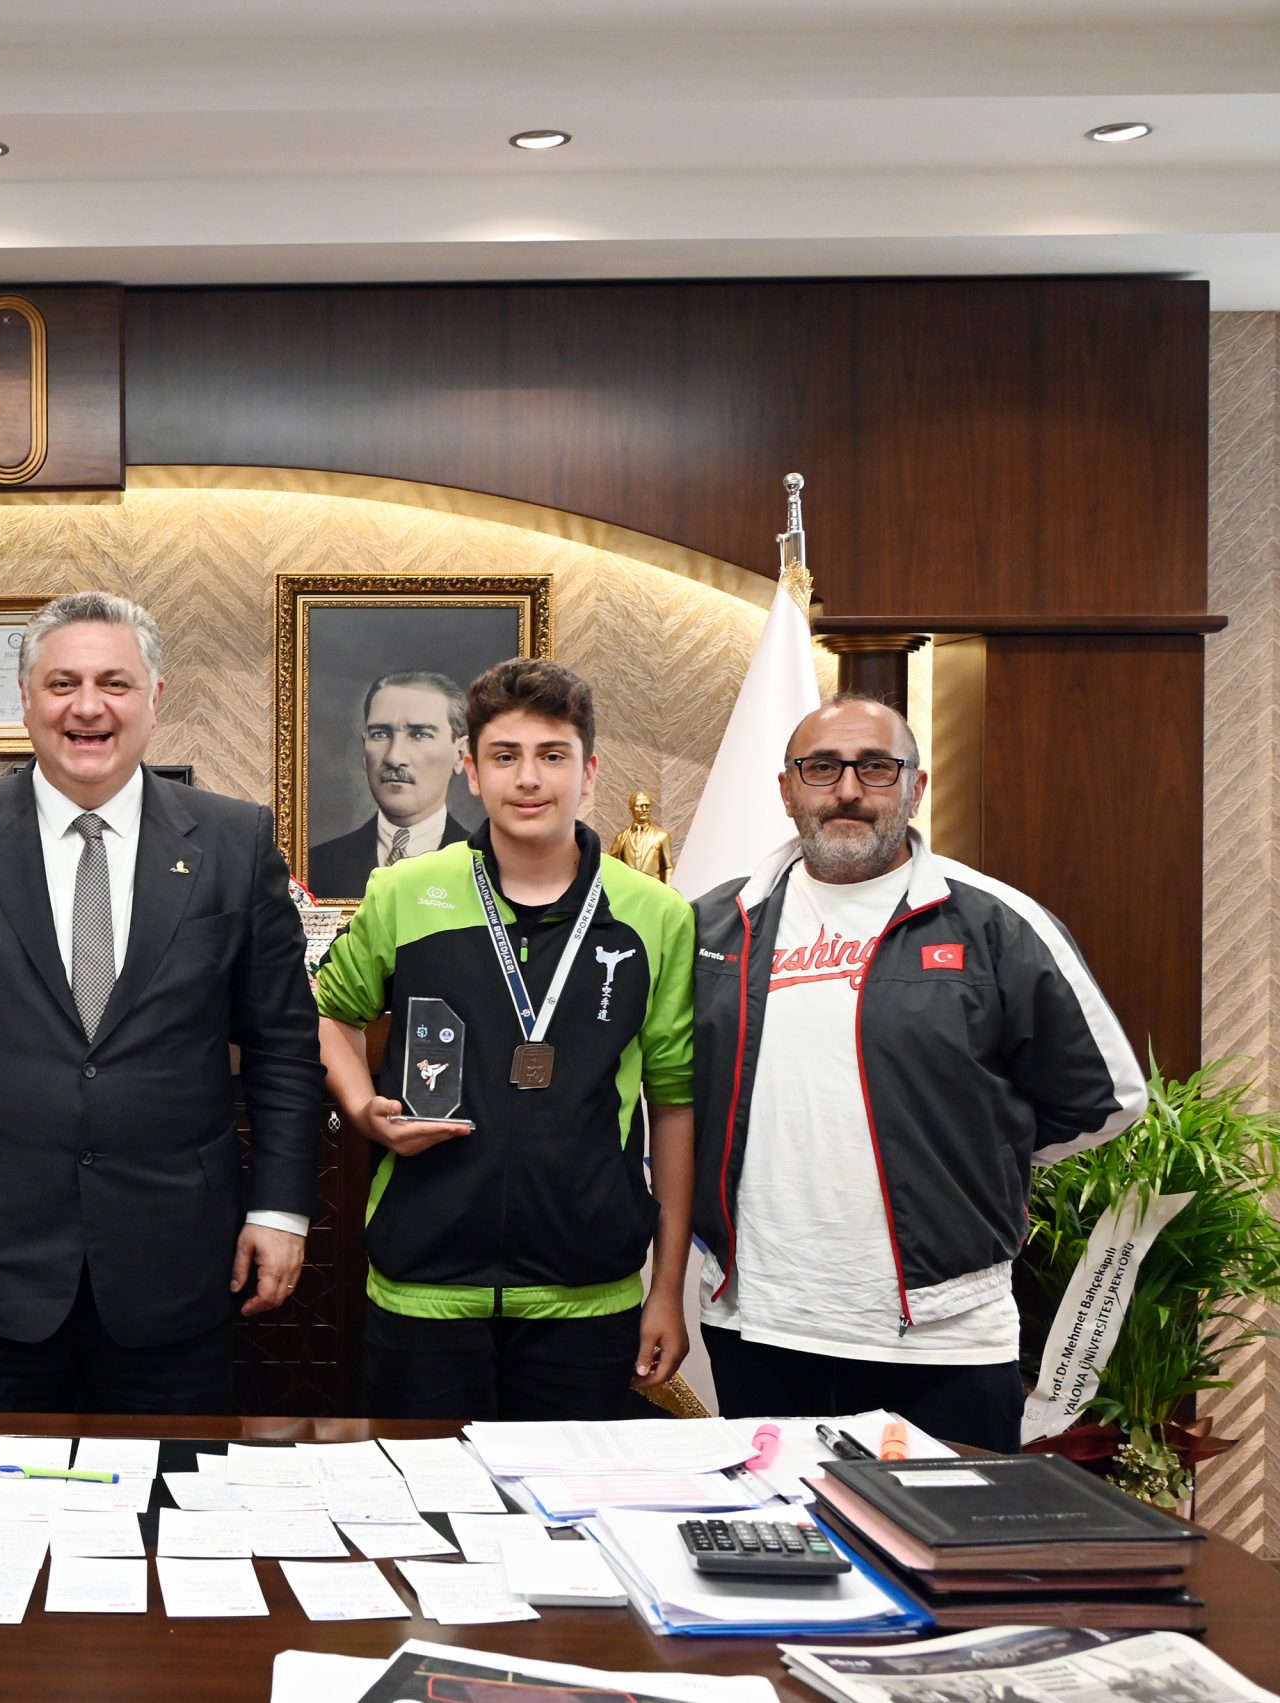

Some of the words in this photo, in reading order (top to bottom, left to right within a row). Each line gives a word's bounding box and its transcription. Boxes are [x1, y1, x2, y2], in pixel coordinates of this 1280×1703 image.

[574, 915, 588, 940] SPOR
[585, 888, 599, 914] KENTİ
[699, 947, 725, 961] Karate
[1081, 1246, 1117, 1310] Bahçekapılı
[1063, 1372, 1089, 1416] YALOVA
[1078, 1295, 1115, 1370] ÜNİVERSİTESİ
[1108, 1241, 1135, 1295] REKTÖRÜ
